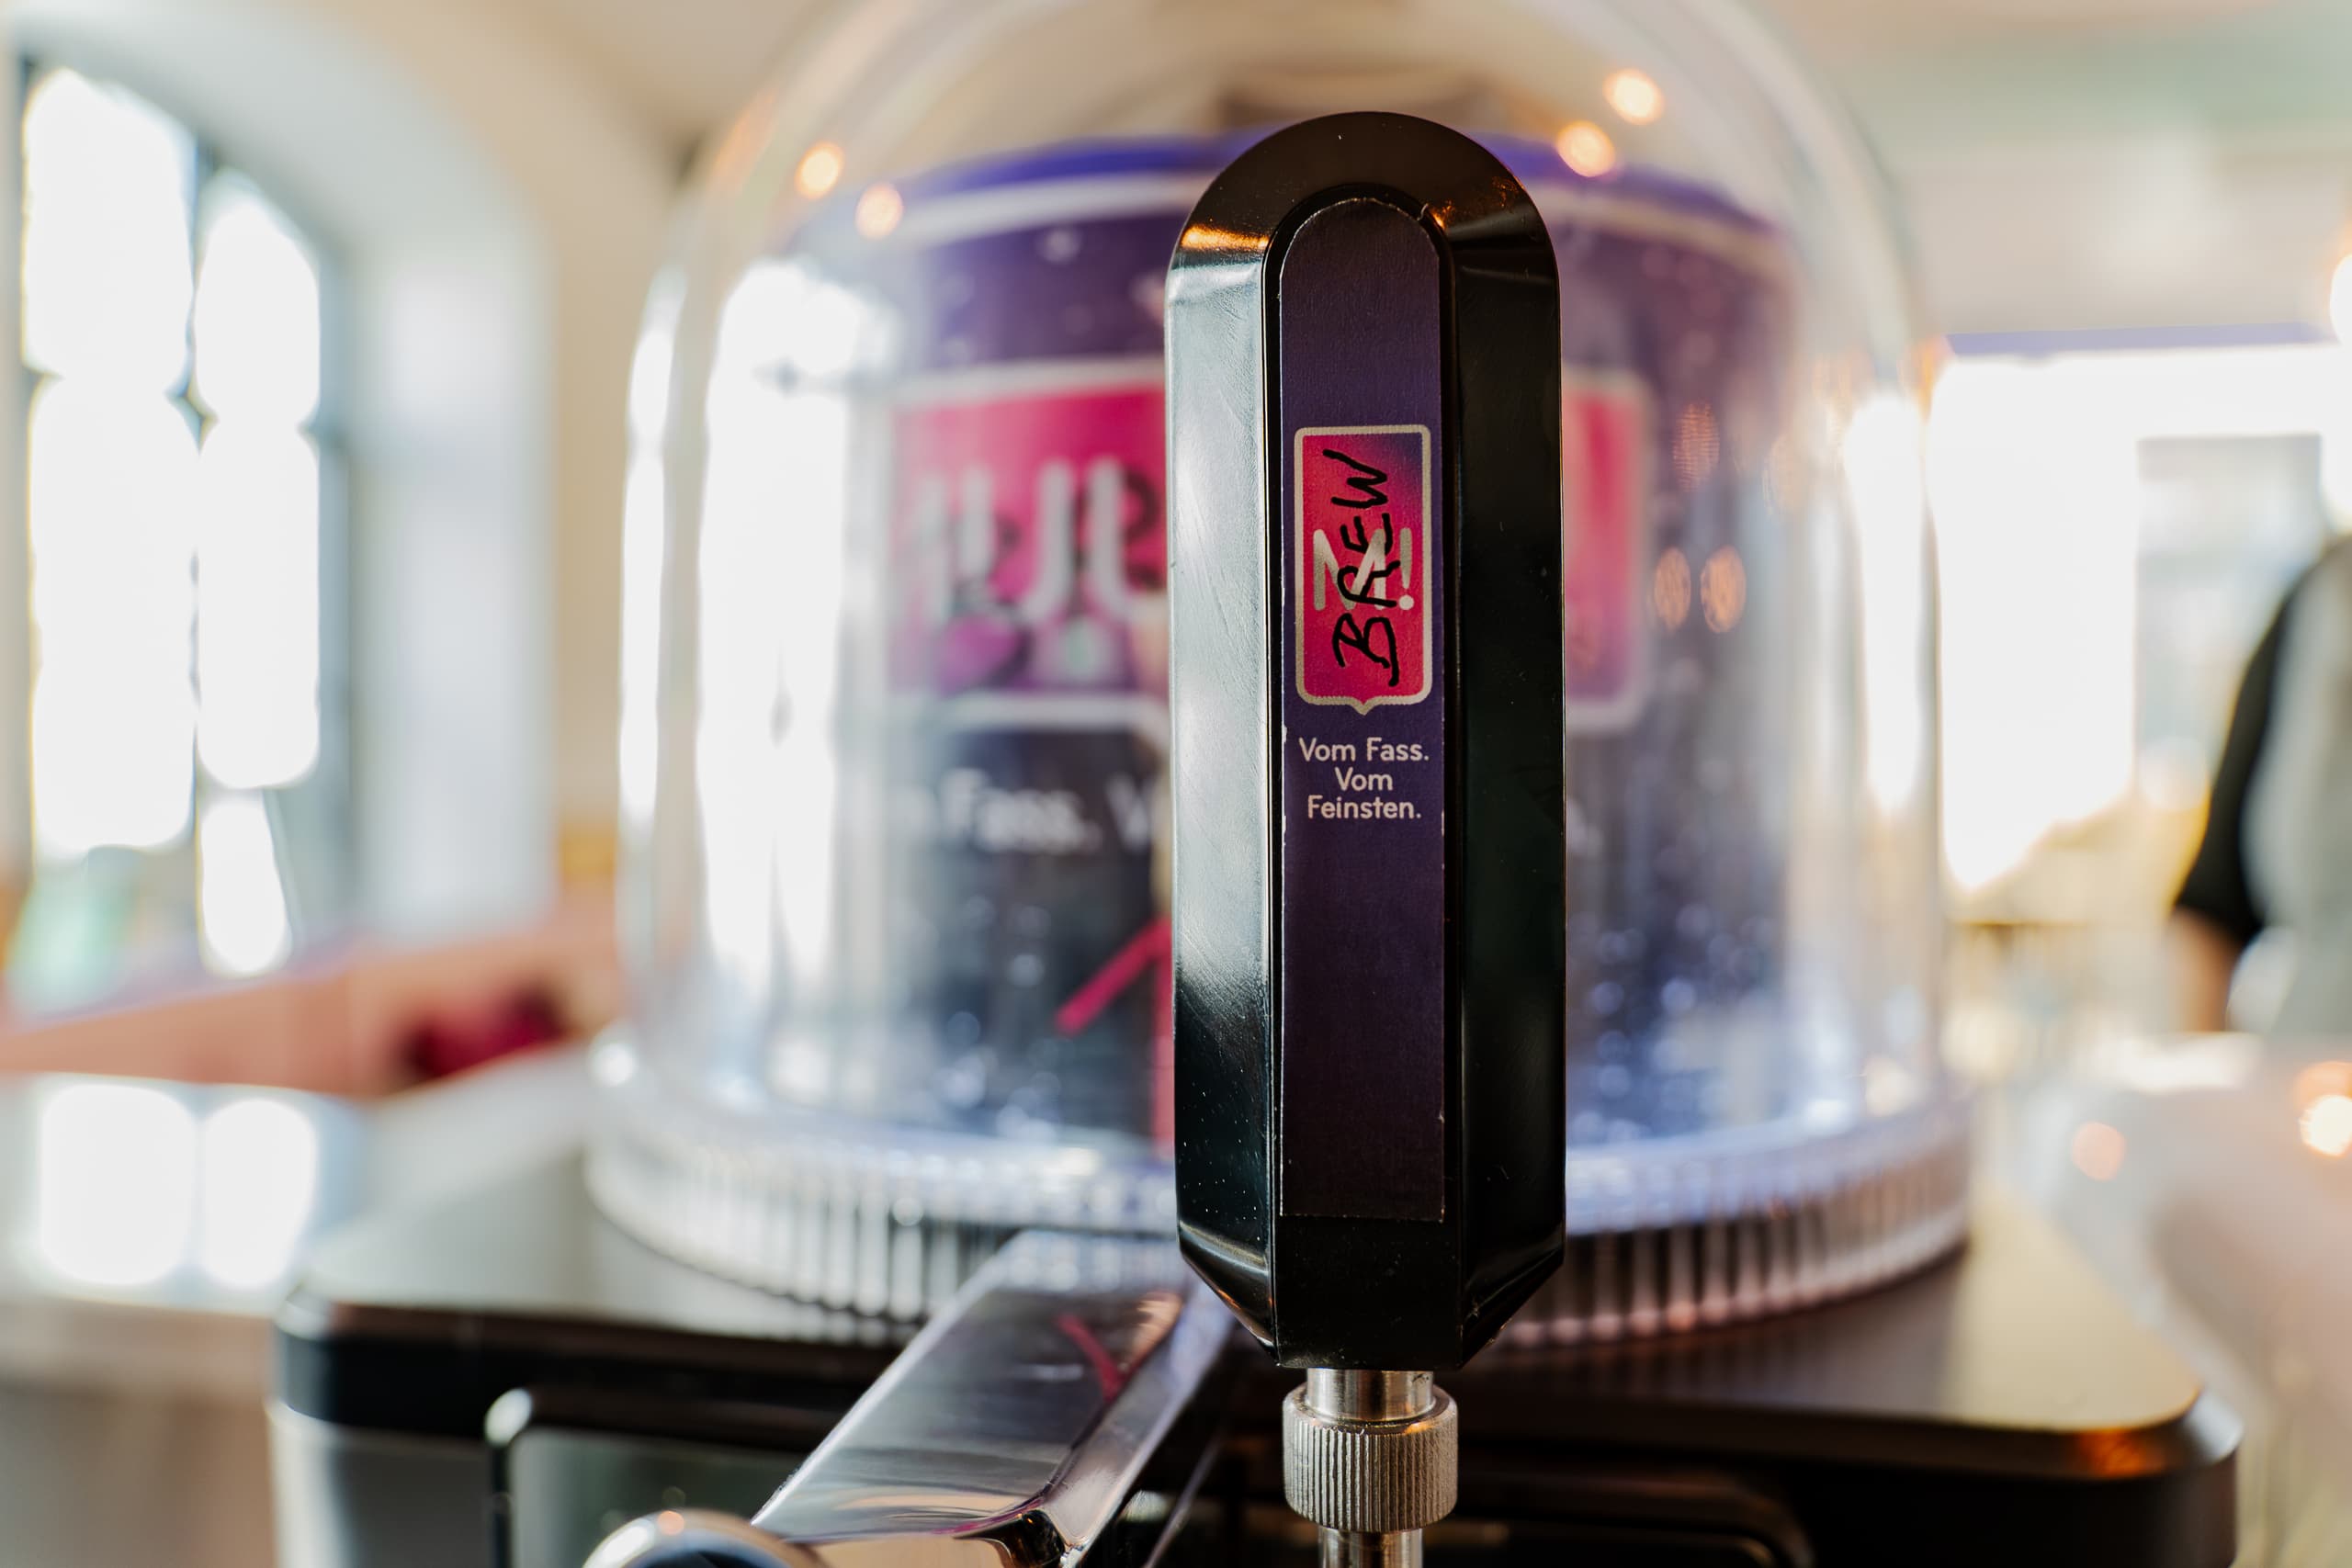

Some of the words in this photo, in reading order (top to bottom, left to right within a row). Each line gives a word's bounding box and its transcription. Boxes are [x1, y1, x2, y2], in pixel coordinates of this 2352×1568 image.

[1322, 448, 1401, 687] BREW
[1298, 737, 1356, 761] Vom
[1366, 737, 1430, 761] Fass.
[1334, 766, 1394, 792] Vom
[1307, 794, 1422, 819] Feinsten.
